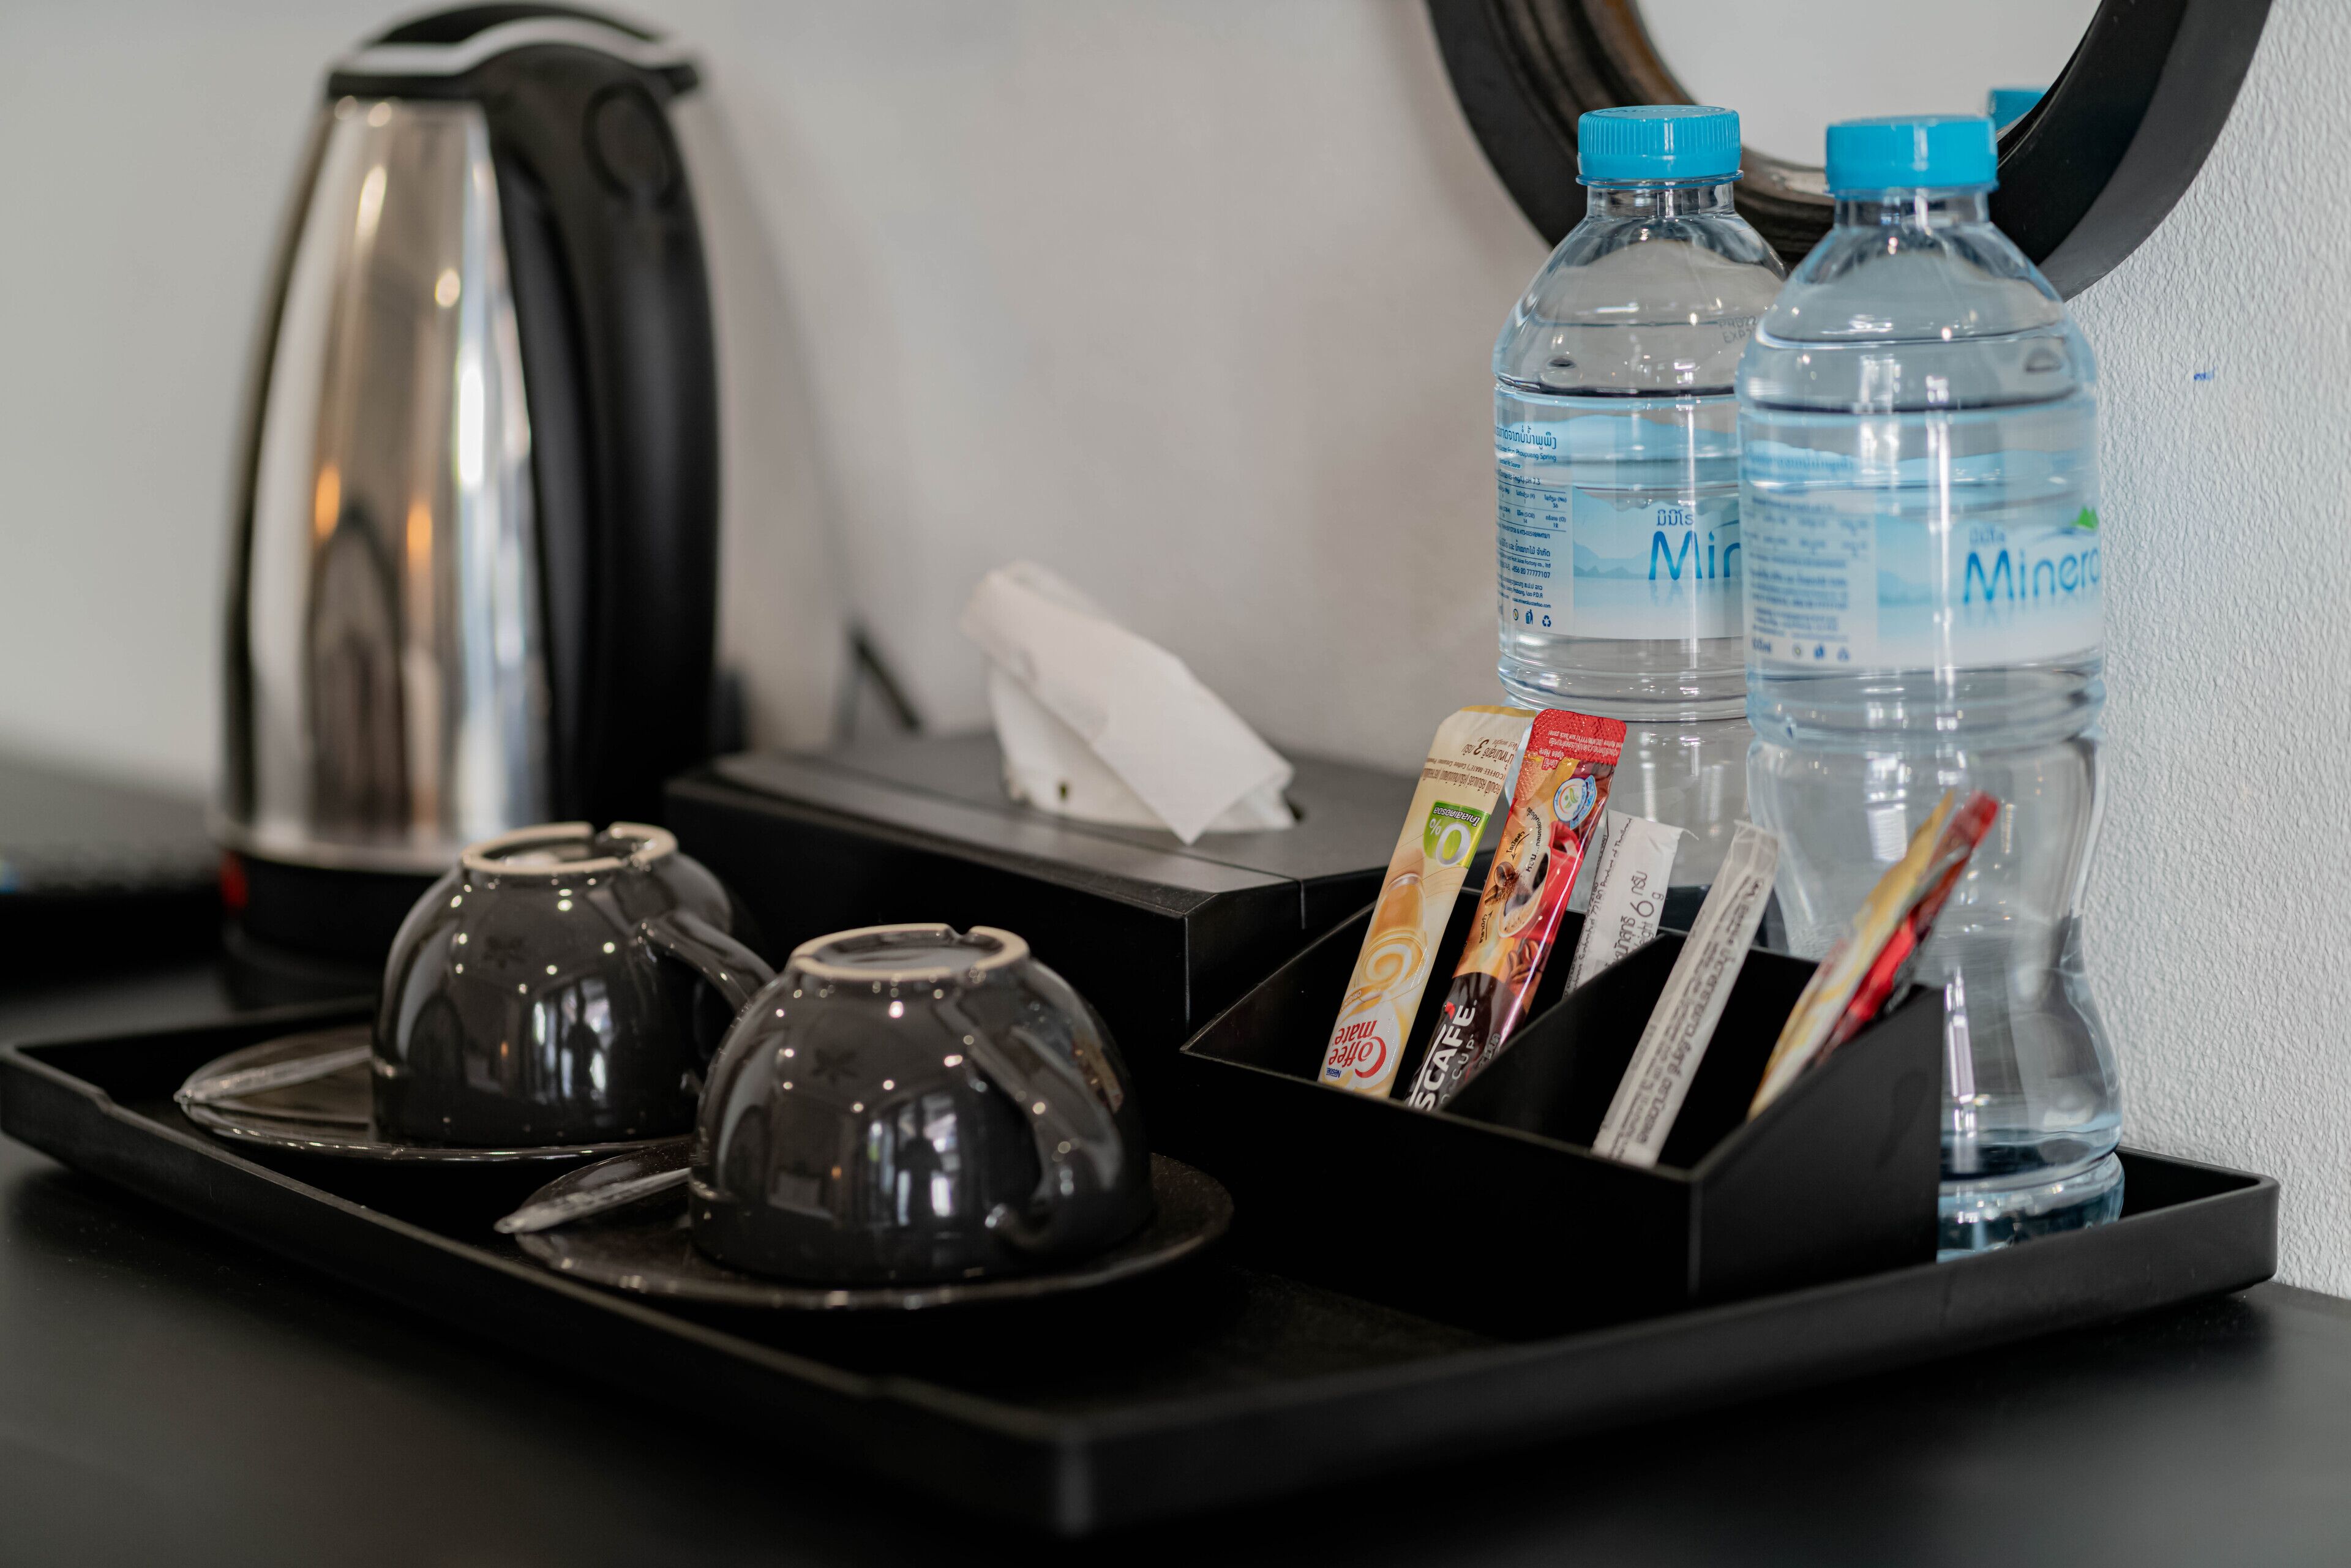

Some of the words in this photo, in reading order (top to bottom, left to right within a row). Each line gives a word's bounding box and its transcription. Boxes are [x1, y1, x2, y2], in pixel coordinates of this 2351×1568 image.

[1540, 453, 1557, 463] Spring
[1473, 739, 1490, 756] 3
[1509, 741, 1518, 751] Net
[1539, 748, 1551, 757] Here
[1552, 750, 1564, 759] Open
[1433, 806, 1481, 827] โคเลสเตอรอล
[1631, 871, 1648, 896] กรัม
[1652, 891, 1664, 901] g
[1630, 900, 1655, 917] 6
[1335, 1020, 1378, 1045] mate
[1329, 1036, 1386, 1078] Coffee
[1452, 1038, 1475, 1080] CUP
